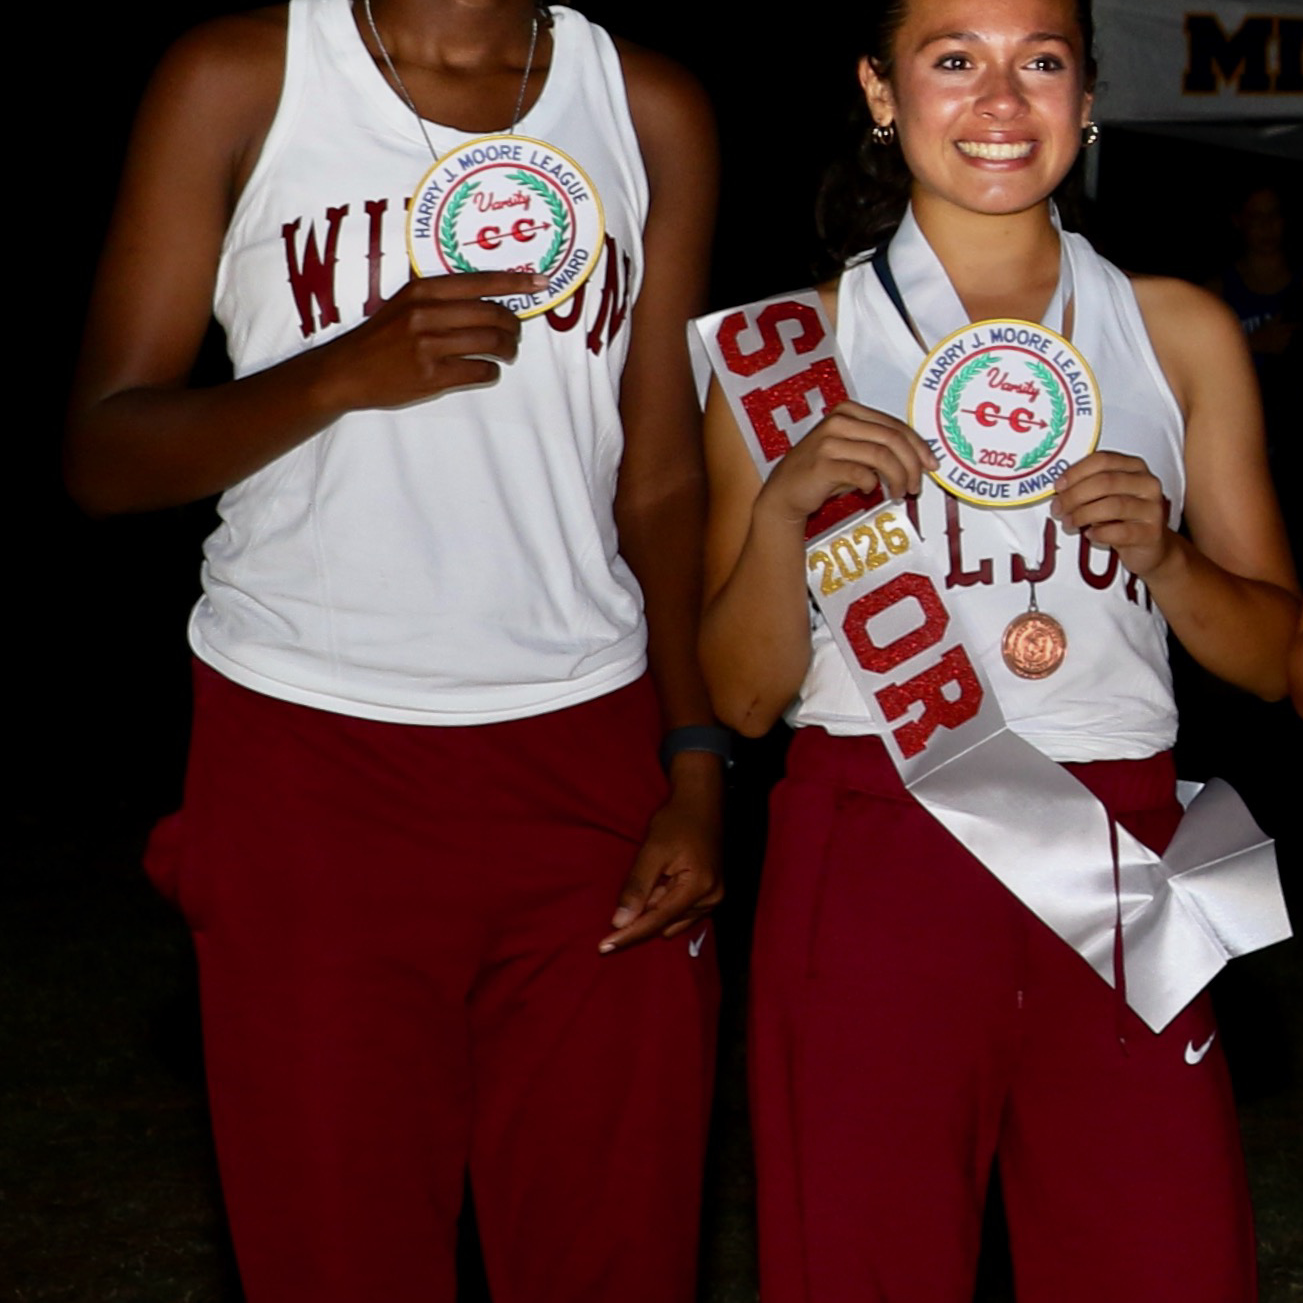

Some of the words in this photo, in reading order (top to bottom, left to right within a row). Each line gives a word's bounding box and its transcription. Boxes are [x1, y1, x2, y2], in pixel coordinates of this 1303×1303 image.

[414, 180, 444, 238] HARRY
[458, 145, 523, 171] MOORE
[530, 151, 590, 204] LEAGUE
[473, 190, 532, 212] Varsity
[548, 248, 589, 298] AWARD
[923, 340, 967, 391] HARRY
[990, 327, 1053, 354] MOORE
[1052, 350, 1092, 417] LEAGUE
[987, 366, 1040, 403] Varsity
[947, 466, 1010, 498] LEAGUE
[1018, 458, 1070, 497] AWARD
[978, 449, 1017, 469] 2025
[808, 511, 910, 597] 2026
